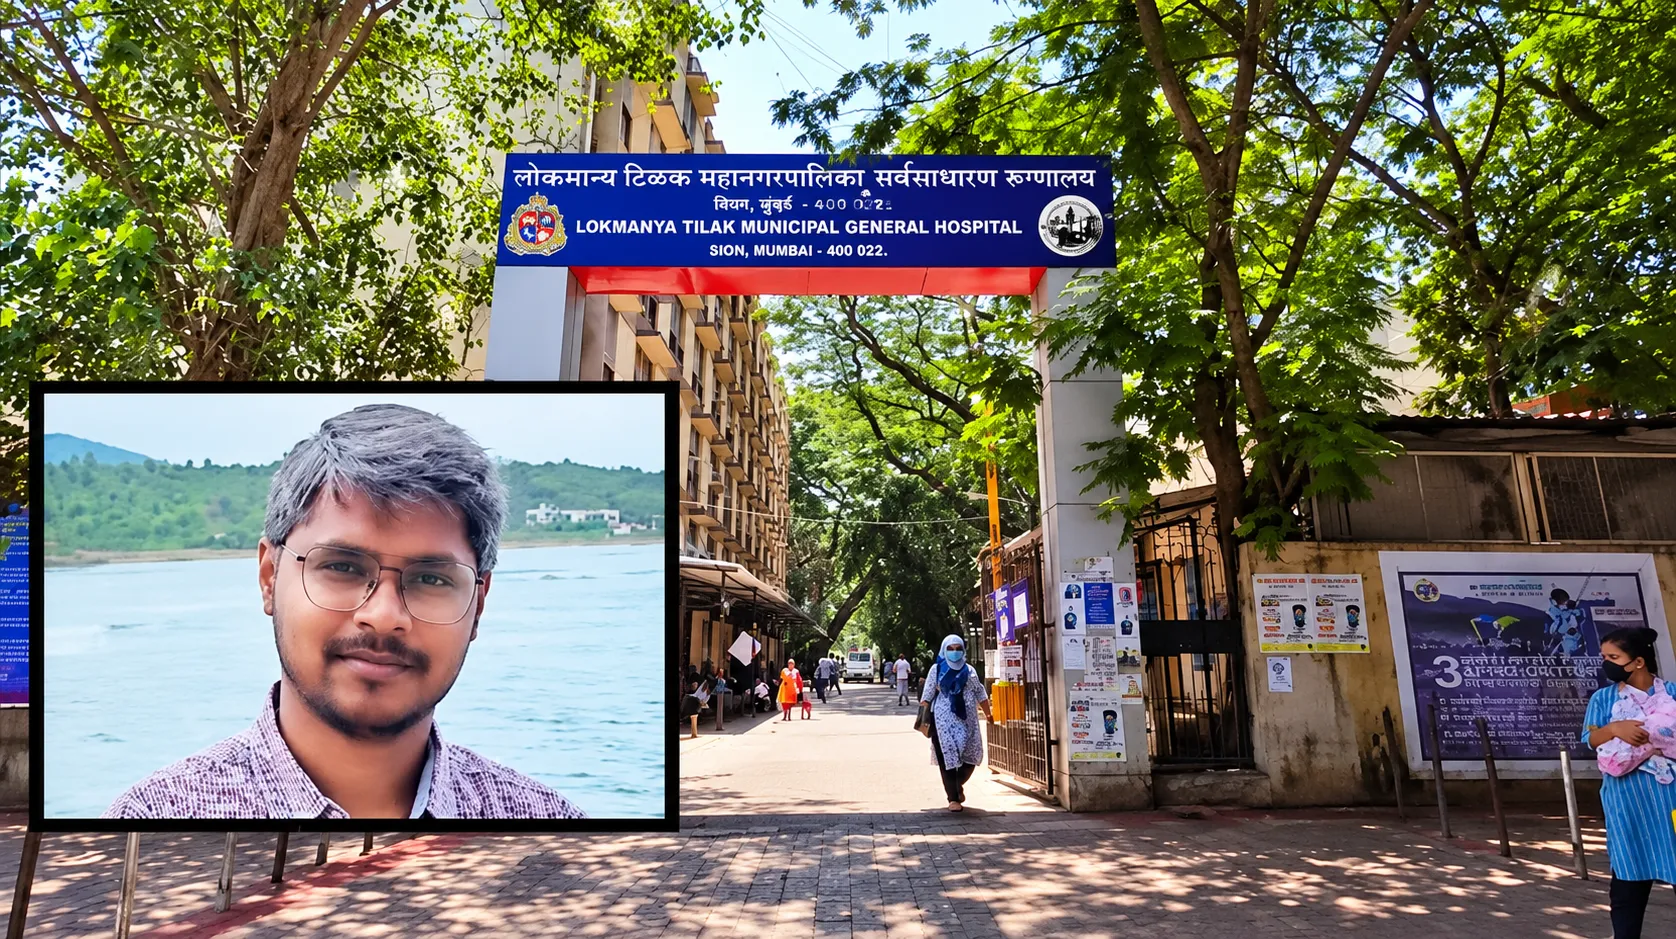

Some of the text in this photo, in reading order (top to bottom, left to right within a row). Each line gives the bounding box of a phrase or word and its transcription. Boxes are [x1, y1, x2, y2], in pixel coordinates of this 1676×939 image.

[513, 162, 618, 187] लोकमान्य
[623, 163, 693, 187] टिळक
[698, 163, 866, 189] महानगरपालिका
[873, 161, 999, 187] सर्वसाधारण
[814, 199, 847, 211] 400
[576, 219, 1023, 235] LOKMANYA TILAK MUNICIPAL GENERAL HOSPITAL
[709, 244, 749, 259] SION,
[753, 244, 813, 257] MUMBAI
[826, 244, 853, 257] 400
[857, 244, 888, 257] 022.
[1433, 655, 1463, 689] 3
